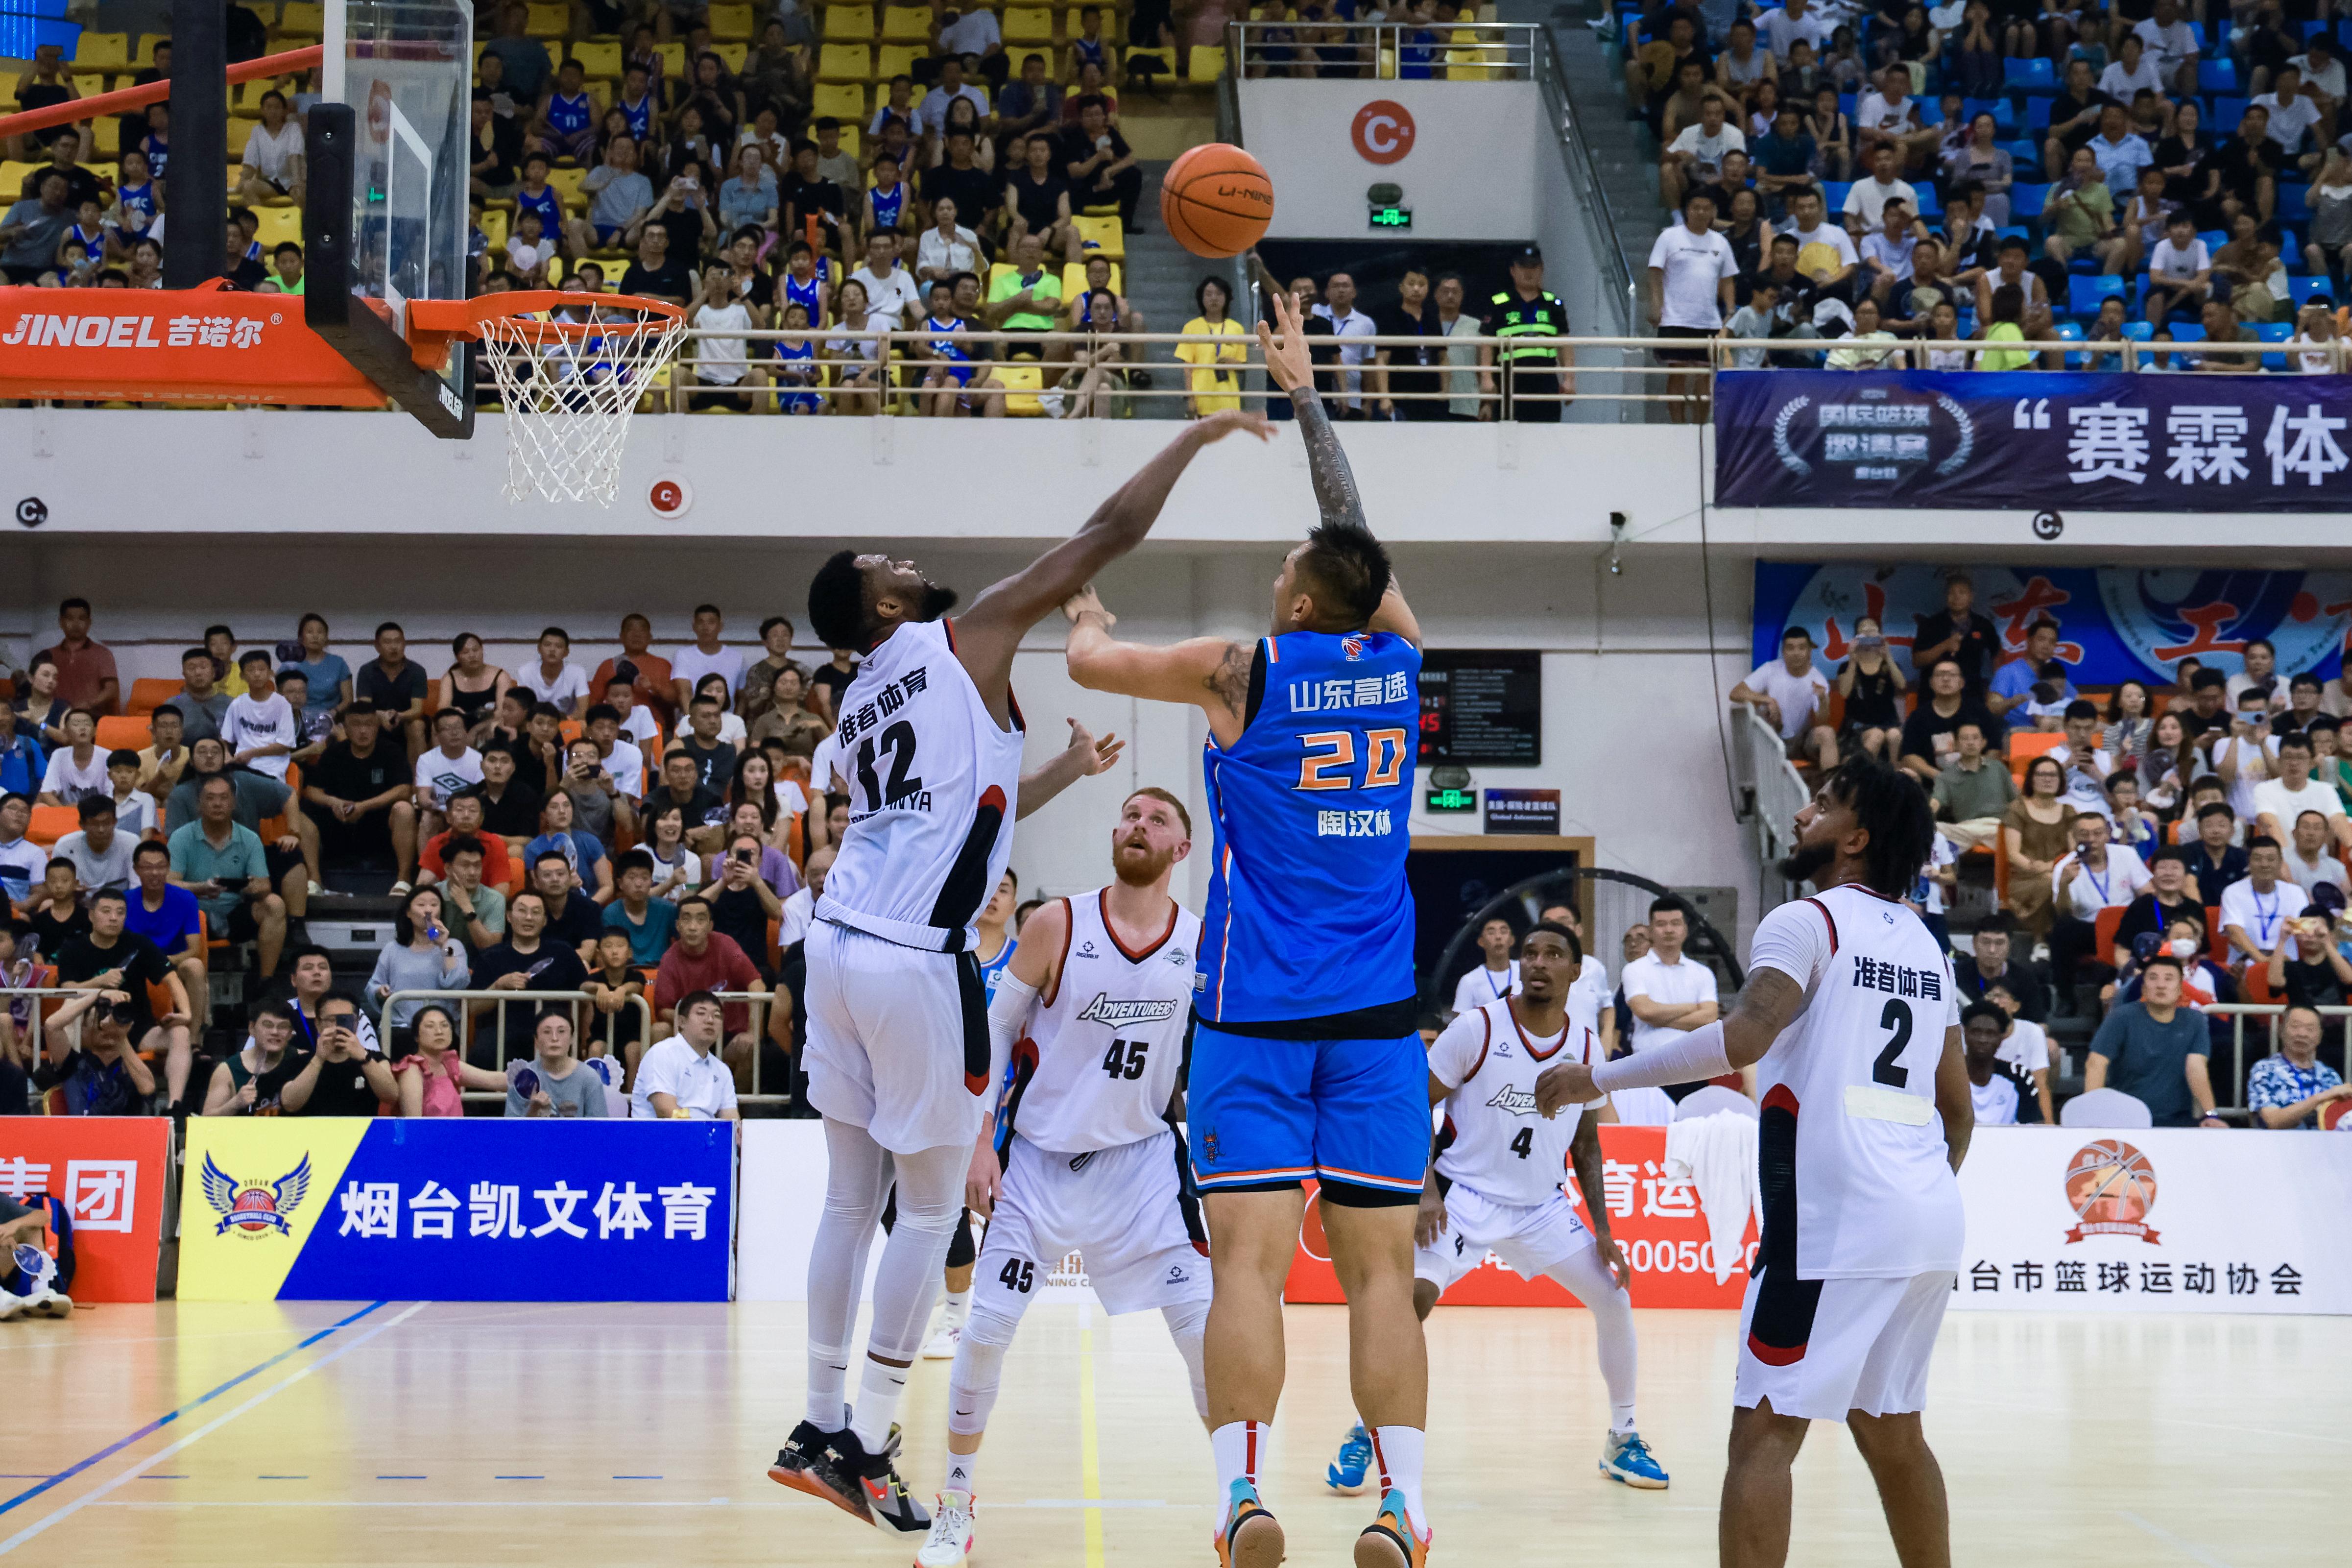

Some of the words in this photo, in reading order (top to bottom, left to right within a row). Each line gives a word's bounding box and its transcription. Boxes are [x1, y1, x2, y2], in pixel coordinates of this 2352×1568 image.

[1365, 115, 1398, 153] C
[2, 314, 160, 347] JINOEL
[168, 315, 264, 349] 吉诺尔
[839, 666, 927, 749] 准者体育
[1289, 670, 1409, 712] 山东高速
[856, 720, 923, 812] 12
[1291, 728, 1407, 791] 20
[1318, 808, 1392, 837] 陶汉林
[1853, 956, 1942, 1001] 准者体育
[1102, 1038, 1150, 1080] 45
[1872, 998, 1913, 1089] 2
[1510, 1127, 1534, 1160] 4
[338, 1180, 717, 1240] 烟台凯文体育
[999, 1257, 1034, 1294] 45
[1953, 1260, 2303, 1296] 台市篮球运动协会
